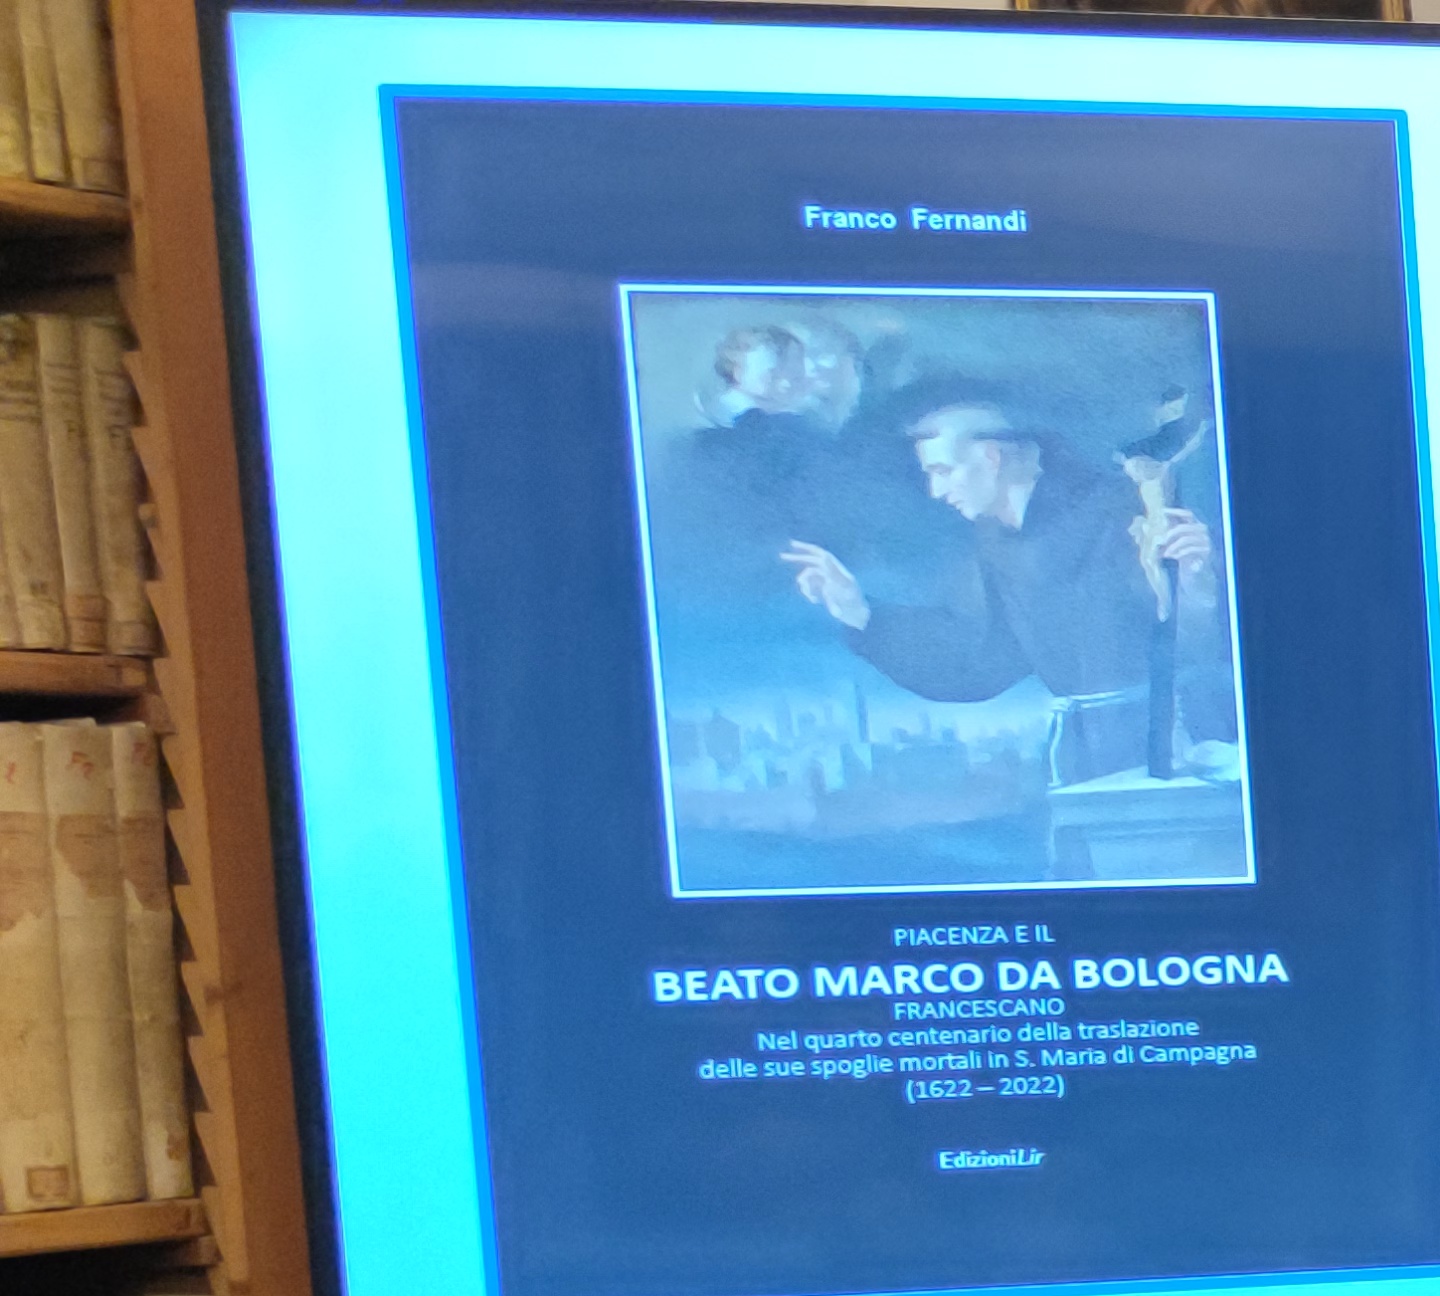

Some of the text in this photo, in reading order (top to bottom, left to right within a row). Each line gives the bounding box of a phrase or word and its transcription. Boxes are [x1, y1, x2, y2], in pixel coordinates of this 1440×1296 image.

[800, 203, 1030, 233] Franco Fernandi
[893, 924, 1057, 948] PIACENZA E IL
[651, 952, 1291, 1004] BEATO MARCO DA BOLOGNA
[893, 996, 1067, 1022] FRANCESCANO
[756, 1018, 1201, 1054] Nel quarto centenario della traslazione
[697, 1042, 1259, 1081] delle sue spoglie mortali in S. Maria di Campagna
[905, 1077, 974, 1105] (1622
[998, 1072, 1066, 1101] 2022)
